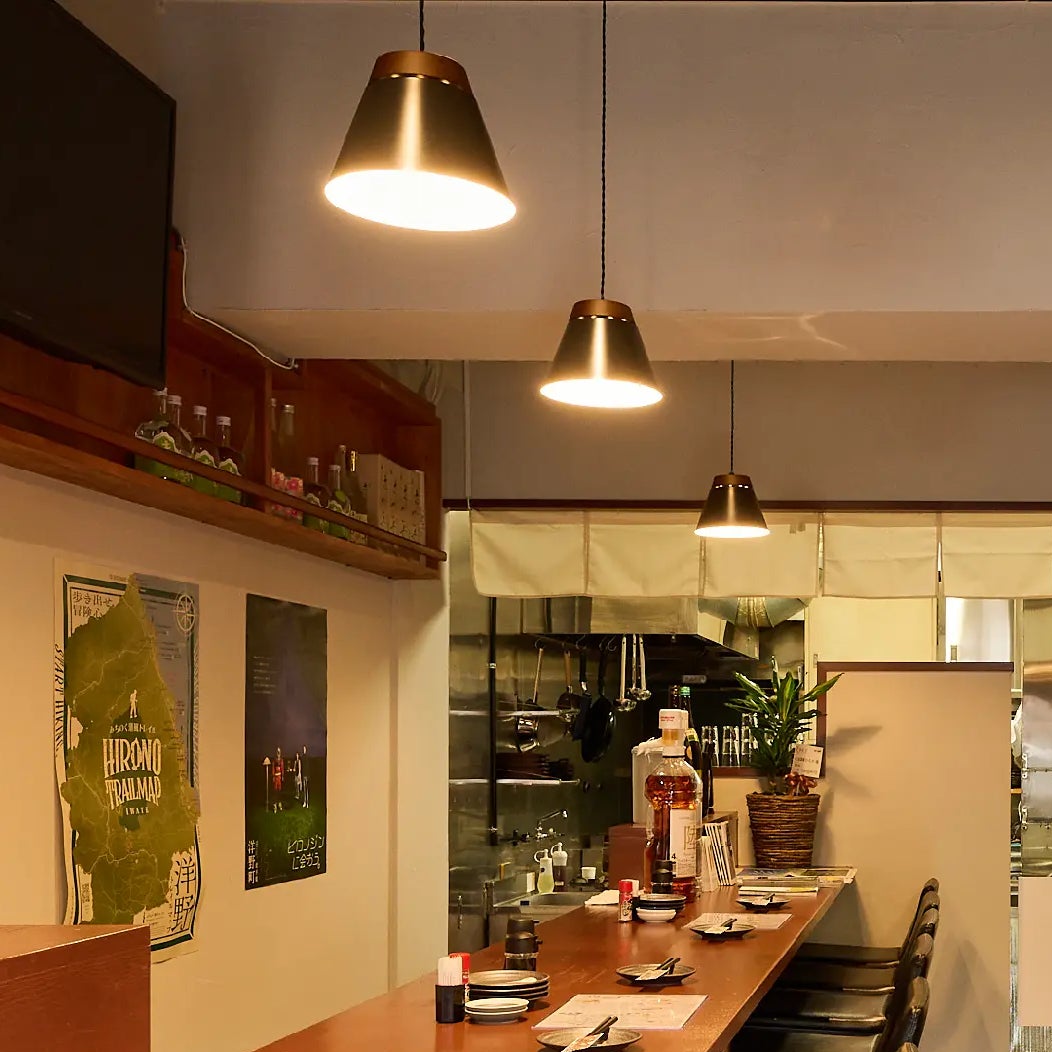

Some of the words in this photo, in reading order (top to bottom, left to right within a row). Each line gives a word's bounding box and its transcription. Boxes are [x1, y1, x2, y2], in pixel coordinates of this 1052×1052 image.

[54, 644, 64, 695] START
[103, 737, 161, 778] HIRONO
[171, 856, 196, 933] 洋野
